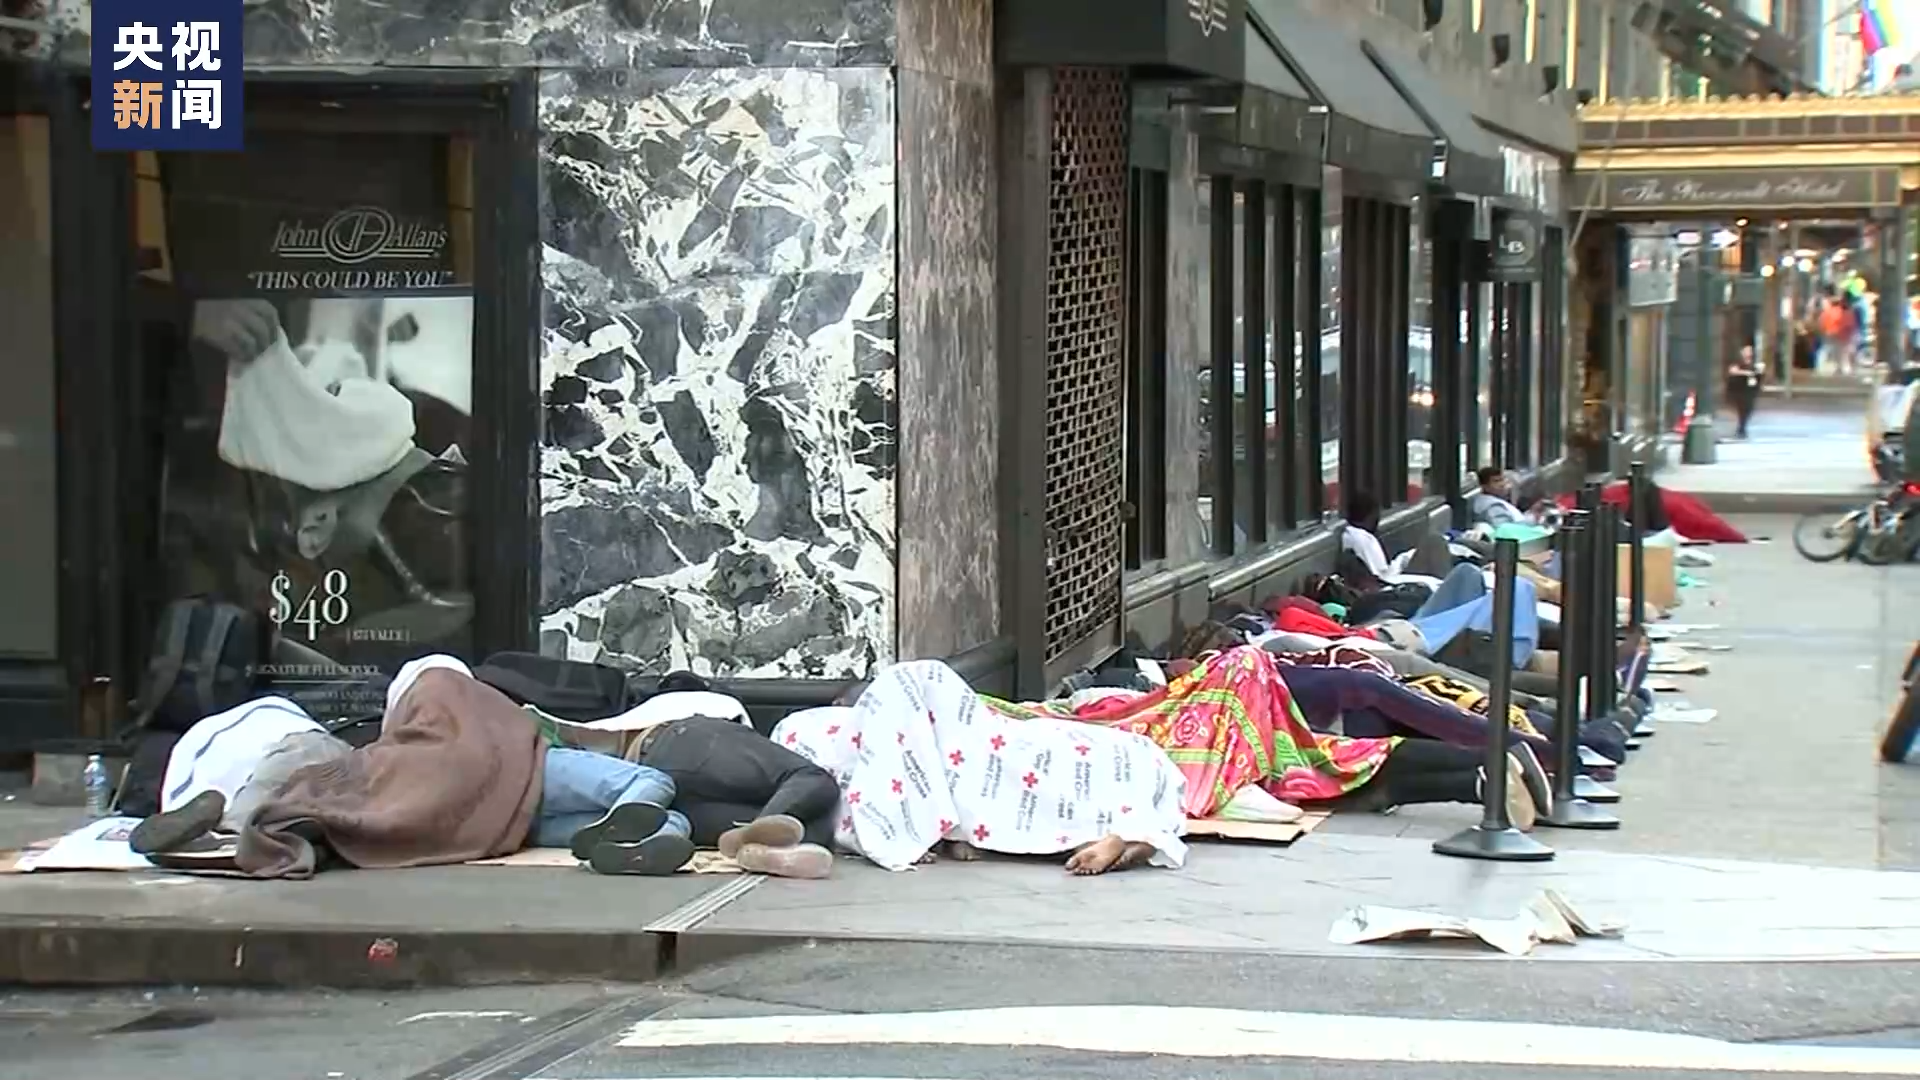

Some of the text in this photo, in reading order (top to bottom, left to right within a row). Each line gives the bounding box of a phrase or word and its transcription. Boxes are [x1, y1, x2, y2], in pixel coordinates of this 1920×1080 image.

[270, 219, 319, 251] John
[302, 271, 370, 289] COULD
[373, 271, 399, 289] BE
[268, 568, 349, 641] $48
